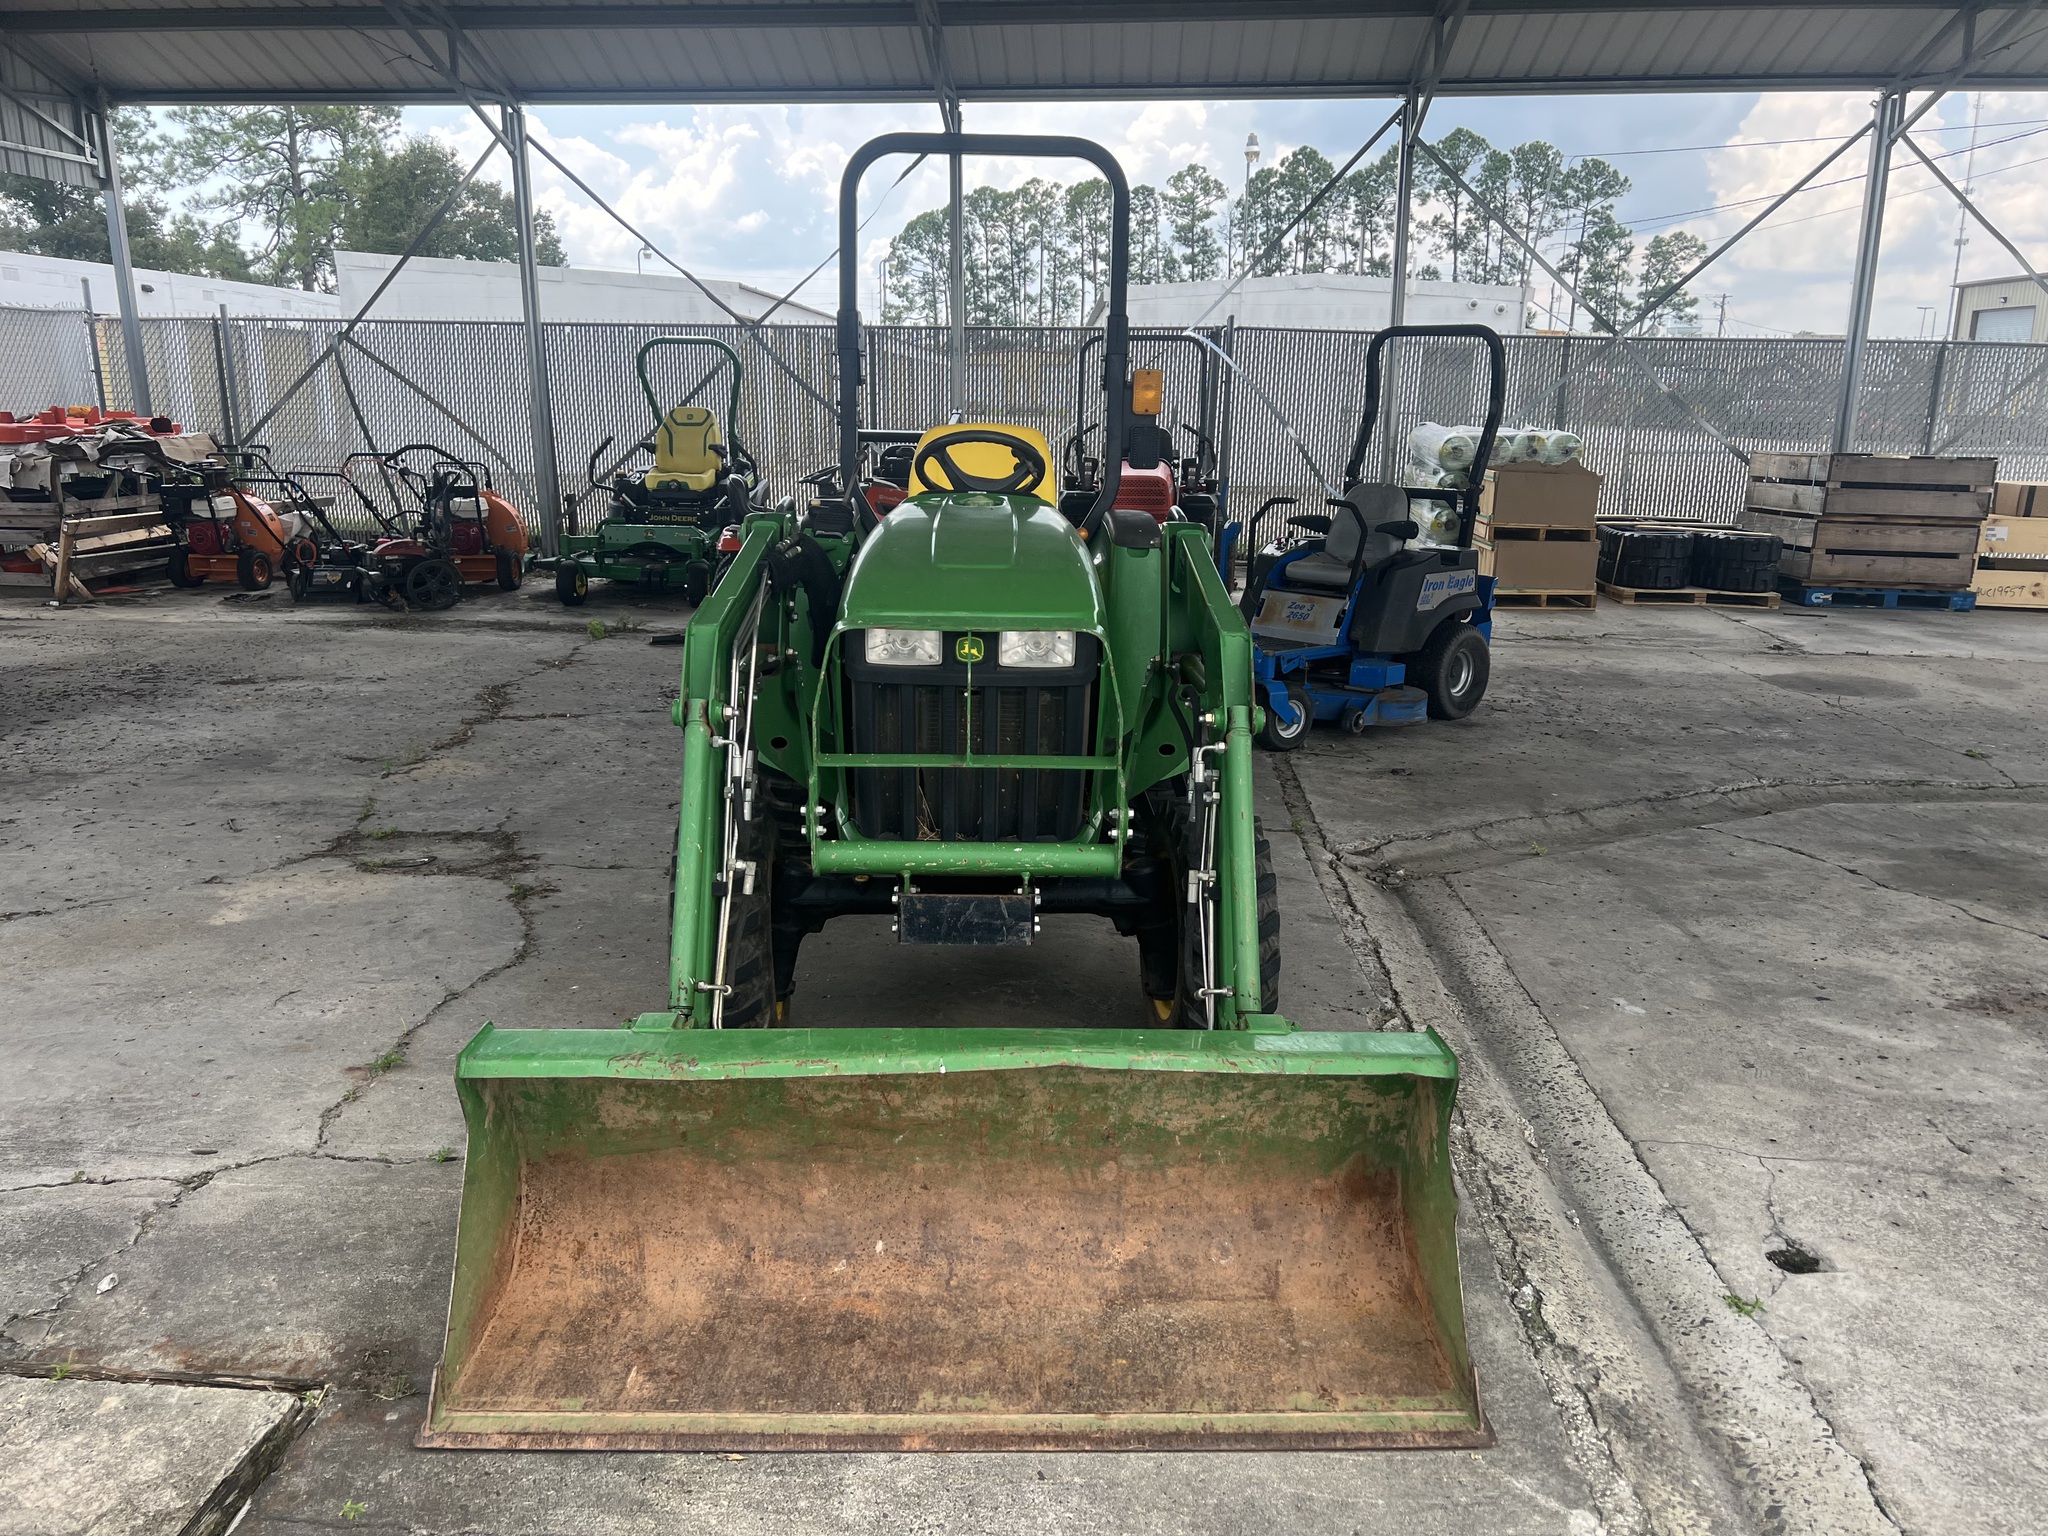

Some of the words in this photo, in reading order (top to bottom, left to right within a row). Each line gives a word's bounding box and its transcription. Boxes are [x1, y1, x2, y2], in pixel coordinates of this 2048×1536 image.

[1423, 579, 1445, 592] Iron
[1447, 574, 1474, 591] Eagle
[1287, 601, 1306, 610] Zoe
[1307, 603, 1315, 612] 3
[1286, 611, 1310, 620] 2650
